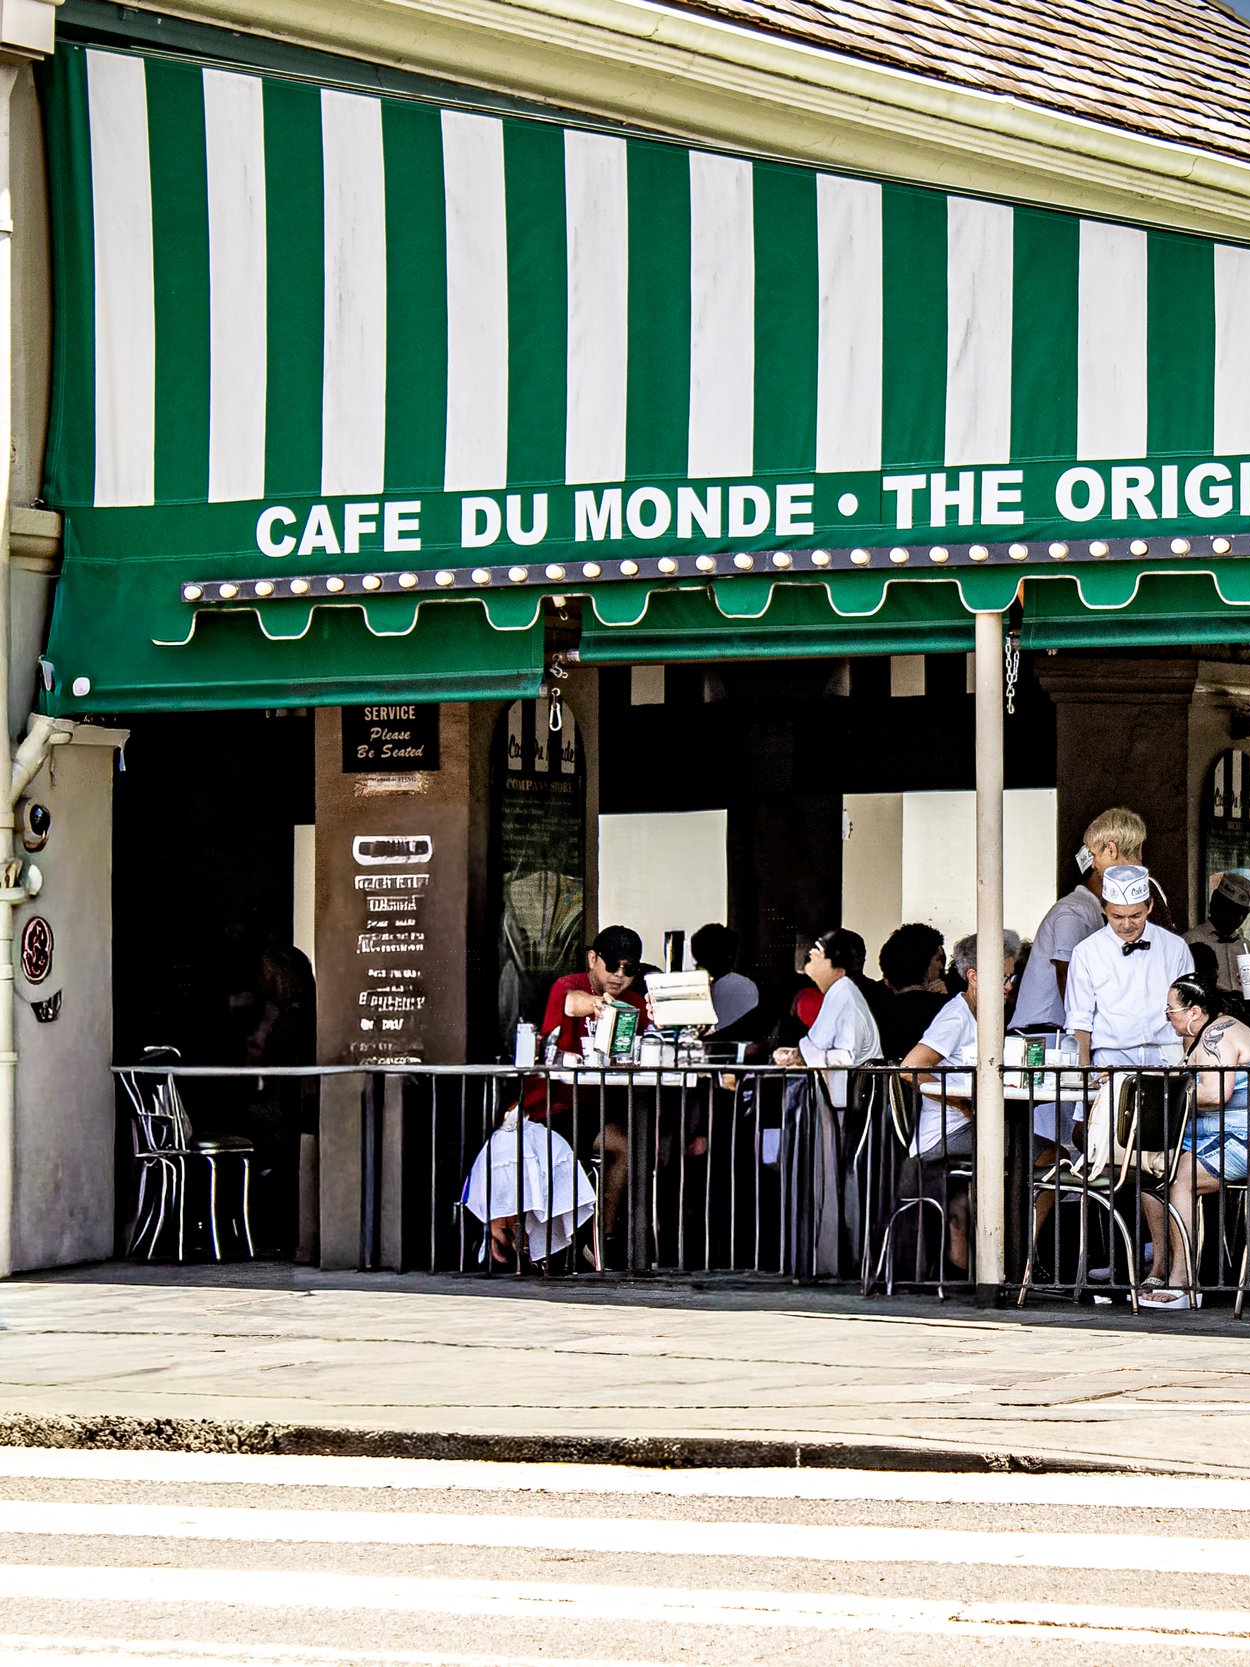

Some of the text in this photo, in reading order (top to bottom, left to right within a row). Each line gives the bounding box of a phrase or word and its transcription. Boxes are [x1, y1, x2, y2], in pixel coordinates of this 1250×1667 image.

[256, 500, 422, 558] CAFE
[461, 493, 548, 548] DU
[574, 483, 815, 542] MONDE
[882, 469, 1025, 530] THE
[364, 705, 416, 720] SERVICE
[369, 727, 411, 741] Please
[357, 744, 424, 758] Be Seated
